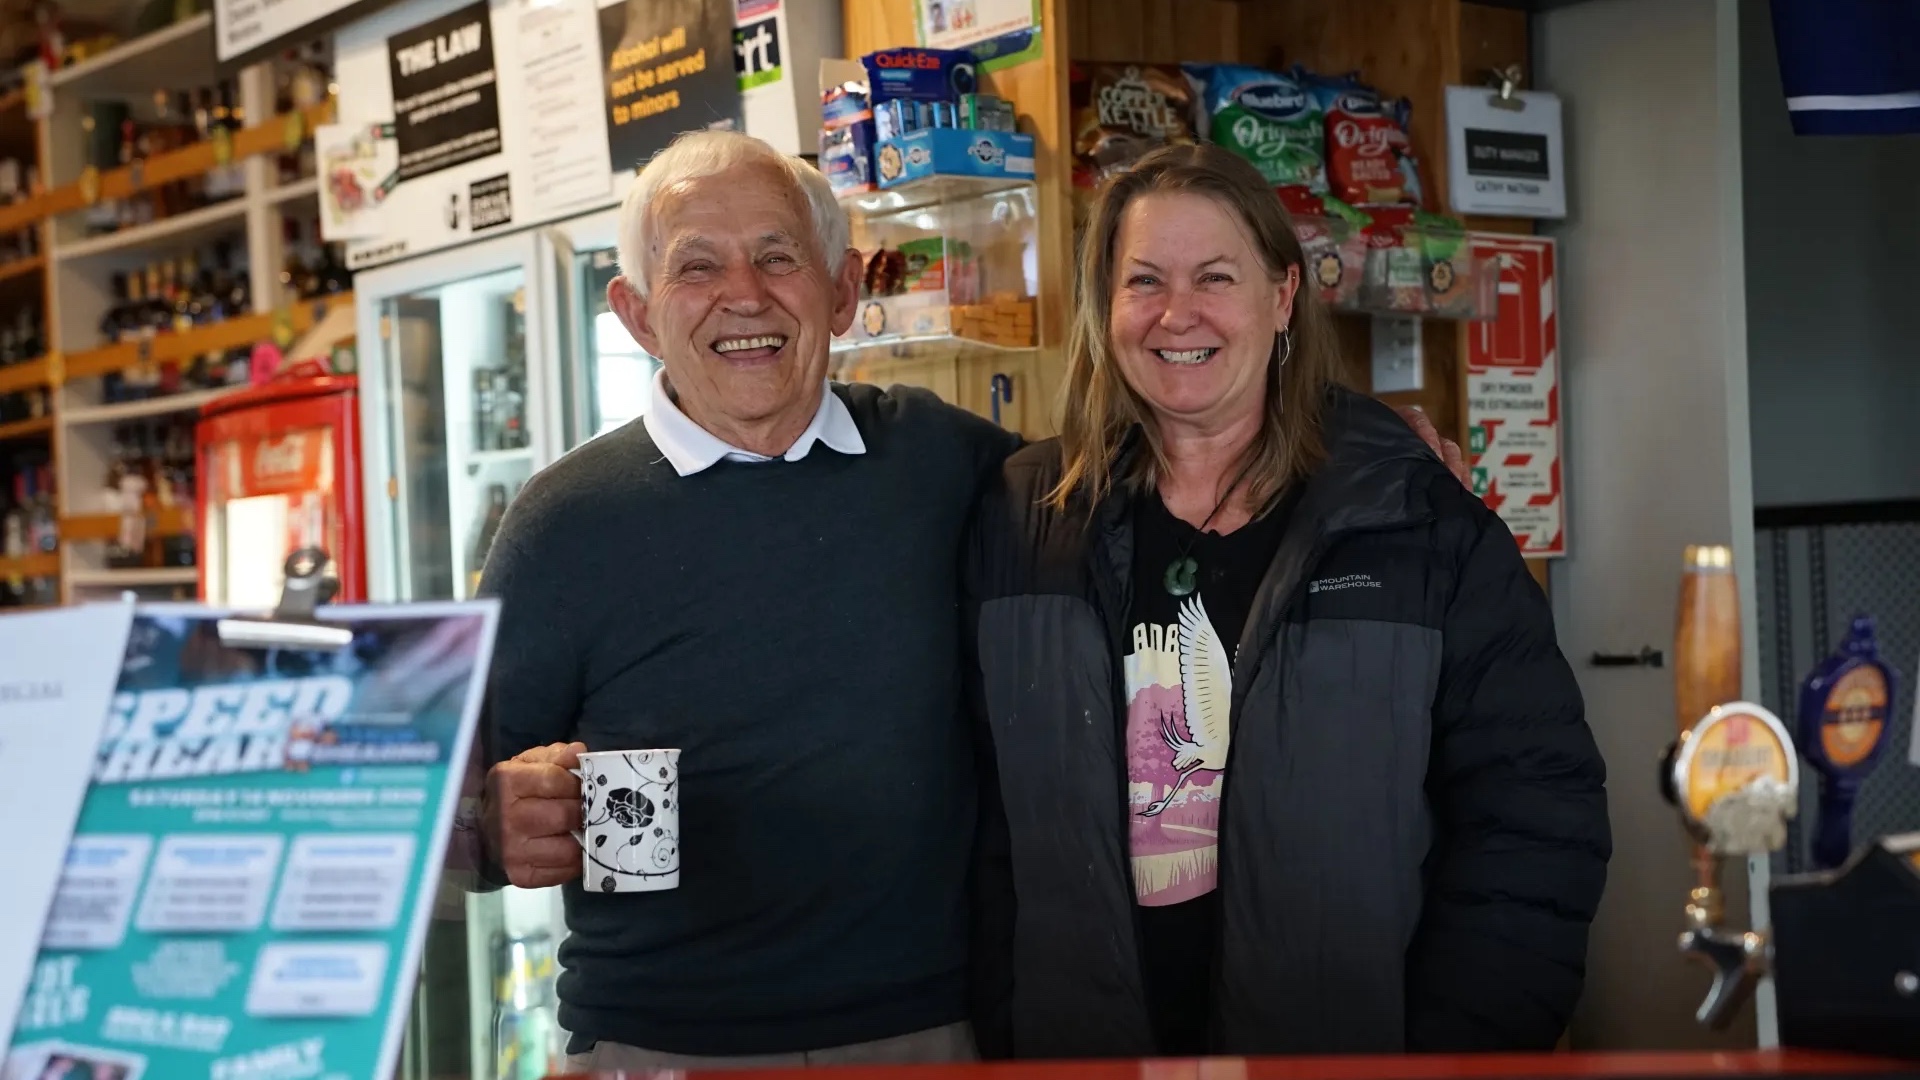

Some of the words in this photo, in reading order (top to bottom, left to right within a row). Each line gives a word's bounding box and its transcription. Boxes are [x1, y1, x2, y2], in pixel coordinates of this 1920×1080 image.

[397, 39, 436, 77] THE
[436, 22, 482, 64] LAW
[611, 36, 660, 72] Alcohol
[660, 25, 686, 53] will
[736, 23, 774, 78] rt
[611, 74, 636, 99] not
[634, 68, 656, 91] be
[655, 48, 706, 84] served
[613, 105, 631, 126] to
[630, 89, 681, 120] minors
[1099, 101, 1178, 132] KETTLE
[1241, 91, 1305, 108] Bluebird
[1319, 574, 1371, 585] MOUNTAIN
[1319, 581, 1382, 591] WAREHOUSE
[97, 733, 291, 783] HEAR
